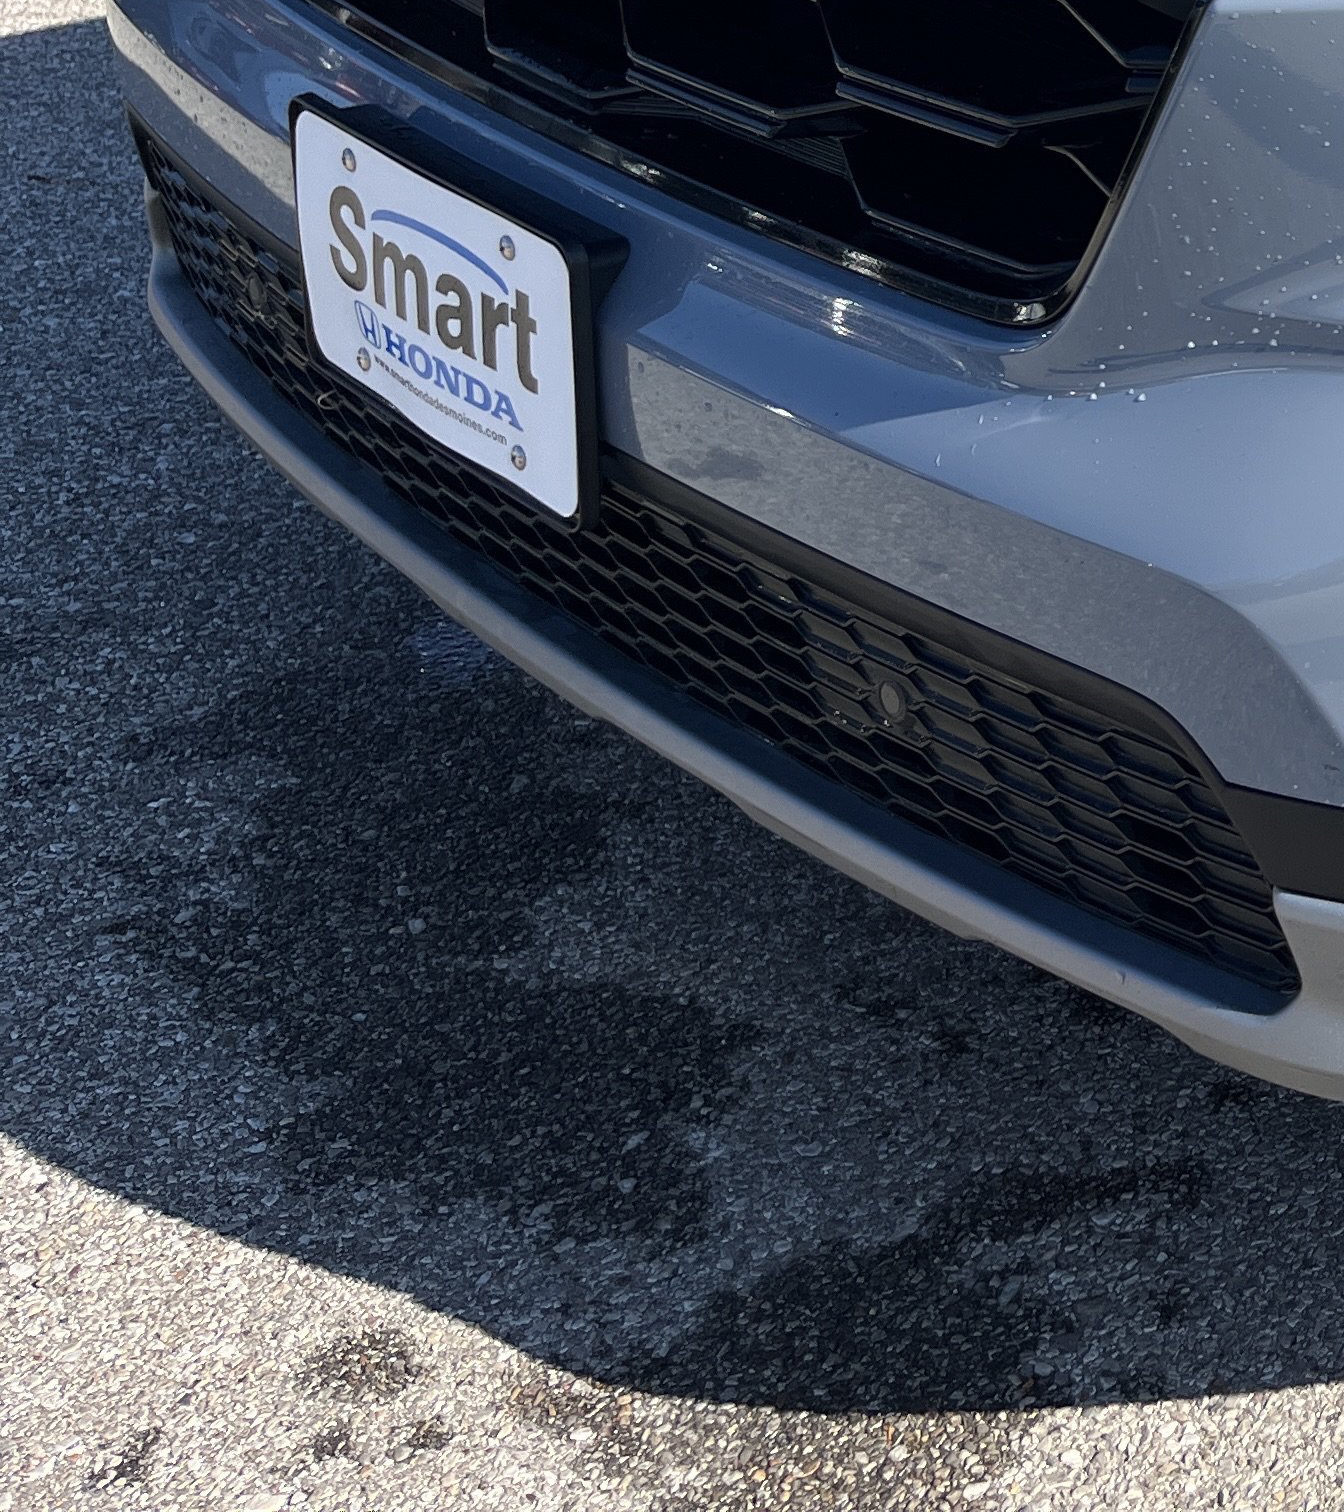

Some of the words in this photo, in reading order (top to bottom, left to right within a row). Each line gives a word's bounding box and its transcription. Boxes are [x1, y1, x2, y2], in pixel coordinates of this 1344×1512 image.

[329, 184, 538, 395] Smart
[373, 354, 508, 446] www.smarthondadesmoines.com
[382, 323, 524, 432] HONDA
